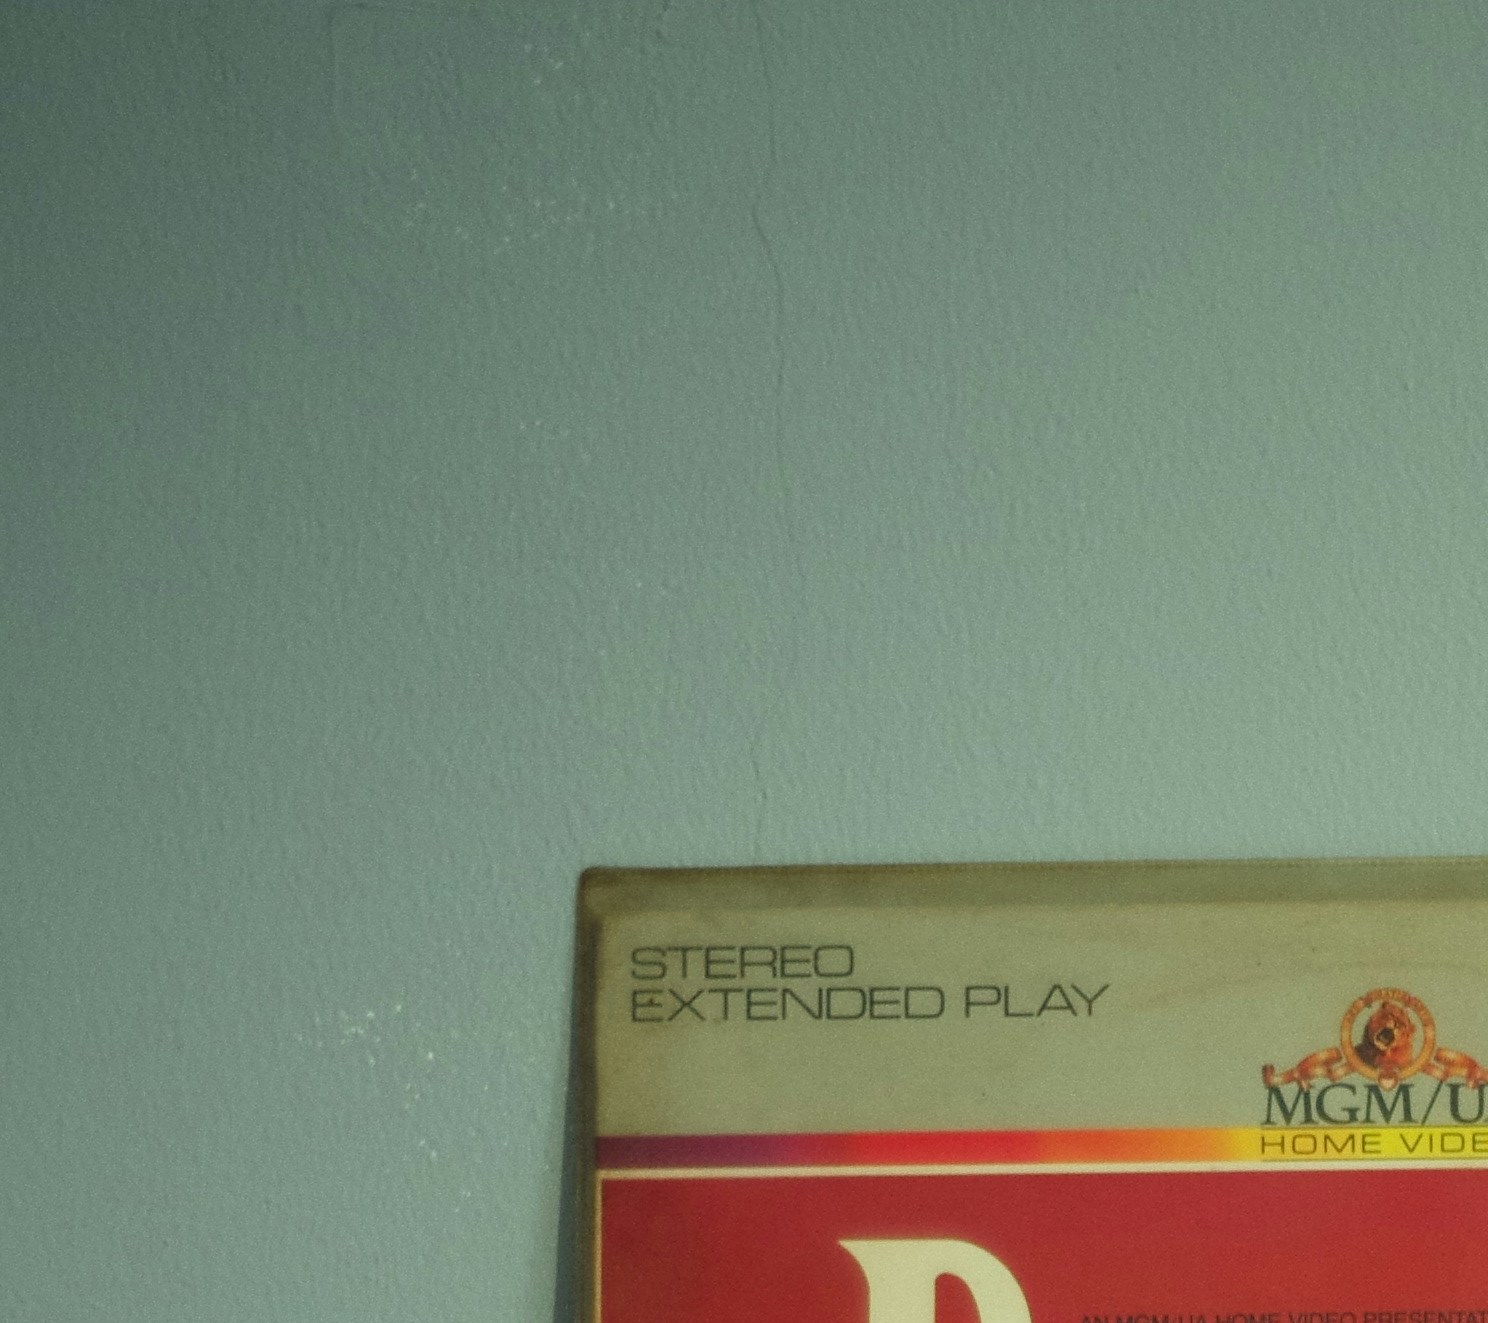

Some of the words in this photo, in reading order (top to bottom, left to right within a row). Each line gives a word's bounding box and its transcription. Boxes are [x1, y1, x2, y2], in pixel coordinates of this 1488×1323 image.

[631, 944, 854, 981] STEREO
[630, 986, 945, 1022] EXTENDED
[964, 984, 1111, 1019] PLAY
[1261, 1133, 1382, 1155] HOME
